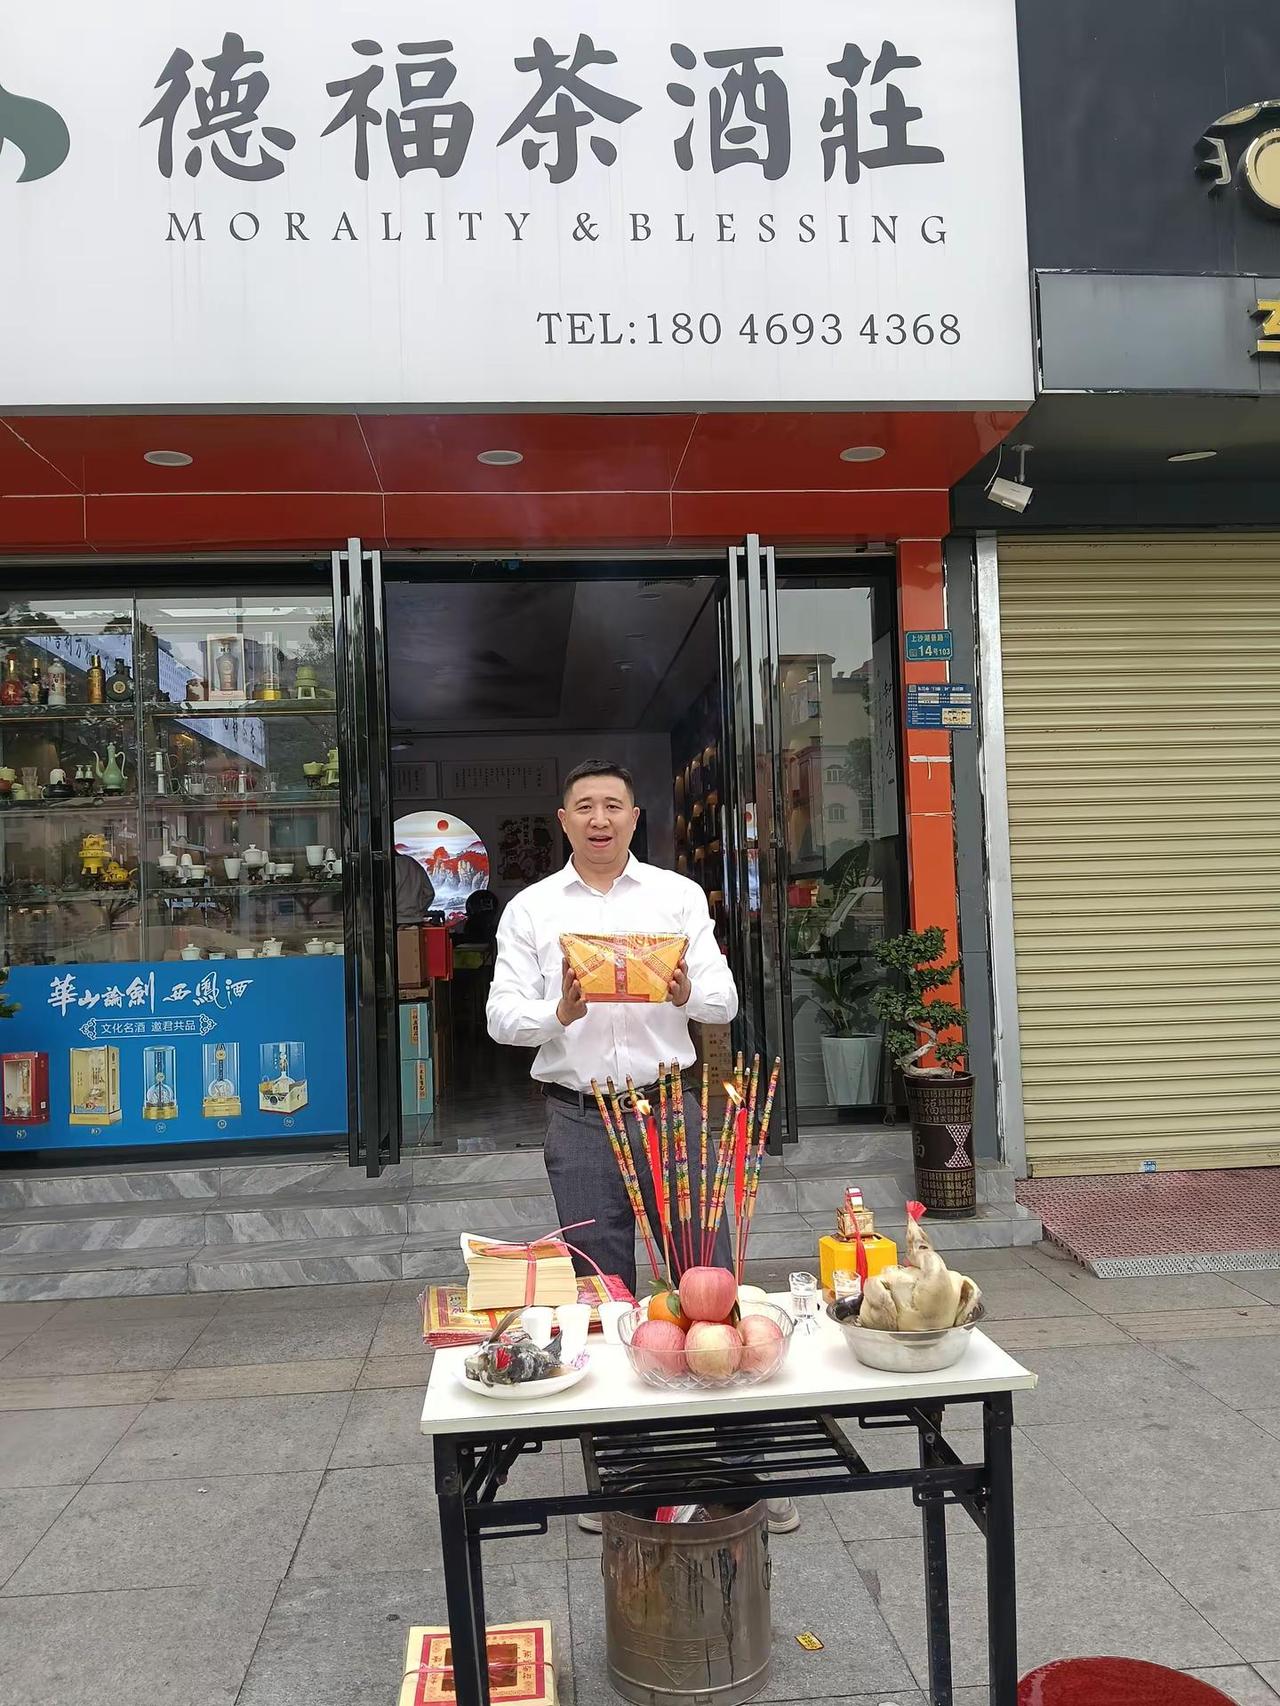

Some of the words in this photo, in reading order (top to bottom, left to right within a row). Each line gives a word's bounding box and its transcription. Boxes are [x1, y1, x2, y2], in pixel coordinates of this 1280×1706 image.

[139, 32, 945, 184] 德福茶酒莊
[165, 211, 531, 242] MORALITY
[629, 212, 947, 244] BLESSING
[739, 312, 842, 346] 4693
[859, 312, 961, 346] 4368
[100, 1022, 146, 1034] 文化名酒
[151, 1020, 196, 1033] 邀君共品
